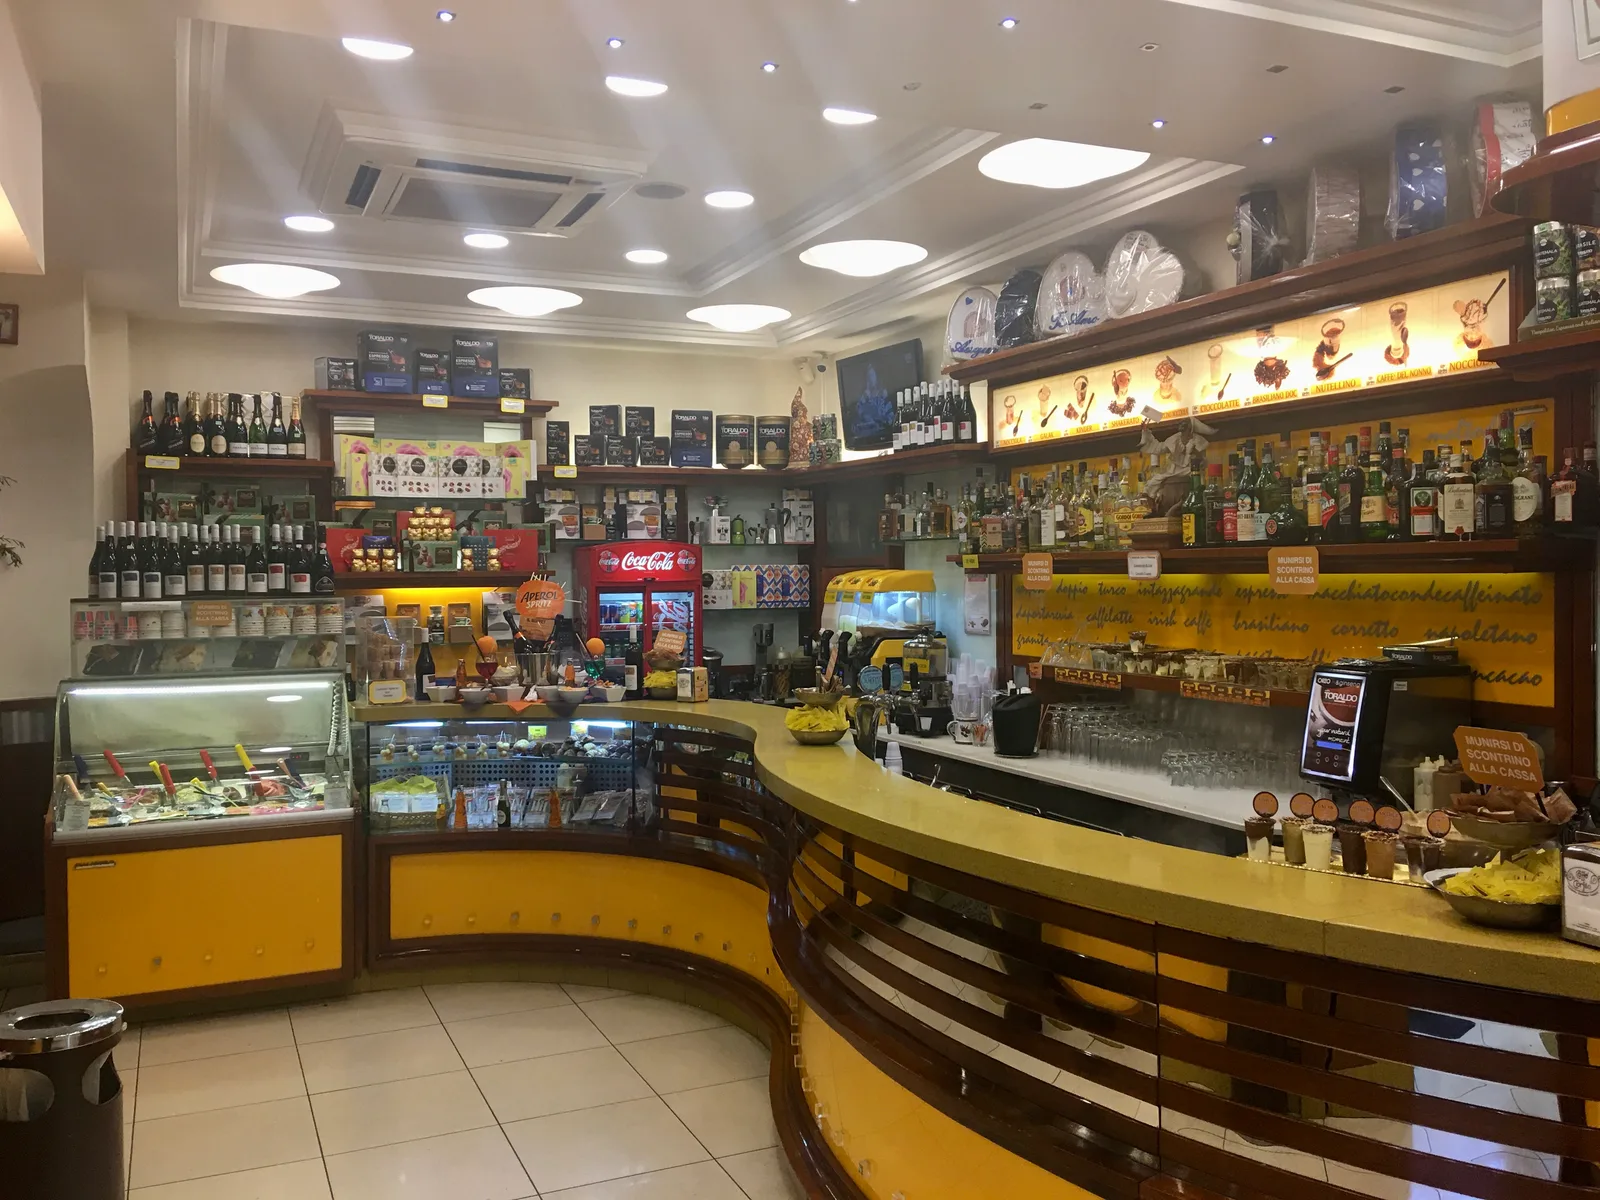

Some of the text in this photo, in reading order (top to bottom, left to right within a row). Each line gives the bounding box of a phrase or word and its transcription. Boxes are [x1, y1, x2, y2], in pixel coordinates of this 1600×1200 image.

[1068, 309, 1099, 326] Amo
[1315, 379, 1357, 393] NUTELLINO
[1252, 392, 1284, 404] BRASILIANO
[621, 551, 676, 571] Coca-Cola
[1277, 556, 1312, 564] MUNIRSI DI
[1276, 566, 1314, 574] SCONTRINO
[1293, 576, 1315, 584] CASSA
[1056, 578, 1088, 600] doppio
[1097, 581, 1127, 596] turco
[520, 591, 558, 604] APEROL
[525, 600, 553, 609] SPRITZ
[1147, 609, 1178, 627] irish
[1233, 610, 1311, 633] brasiliano
[1331, 620, 1400, 638] corretto
[1424, 619, 1538, 646] napoletano
[1324, 691, 1358, 703] TORALDO
[1464, 735, 1525, 753] MUNIRSI DI
[1466, 748, 1532, 767] SCONTRINO
[1469, 761, 1538, 782] ALLA CASSA
